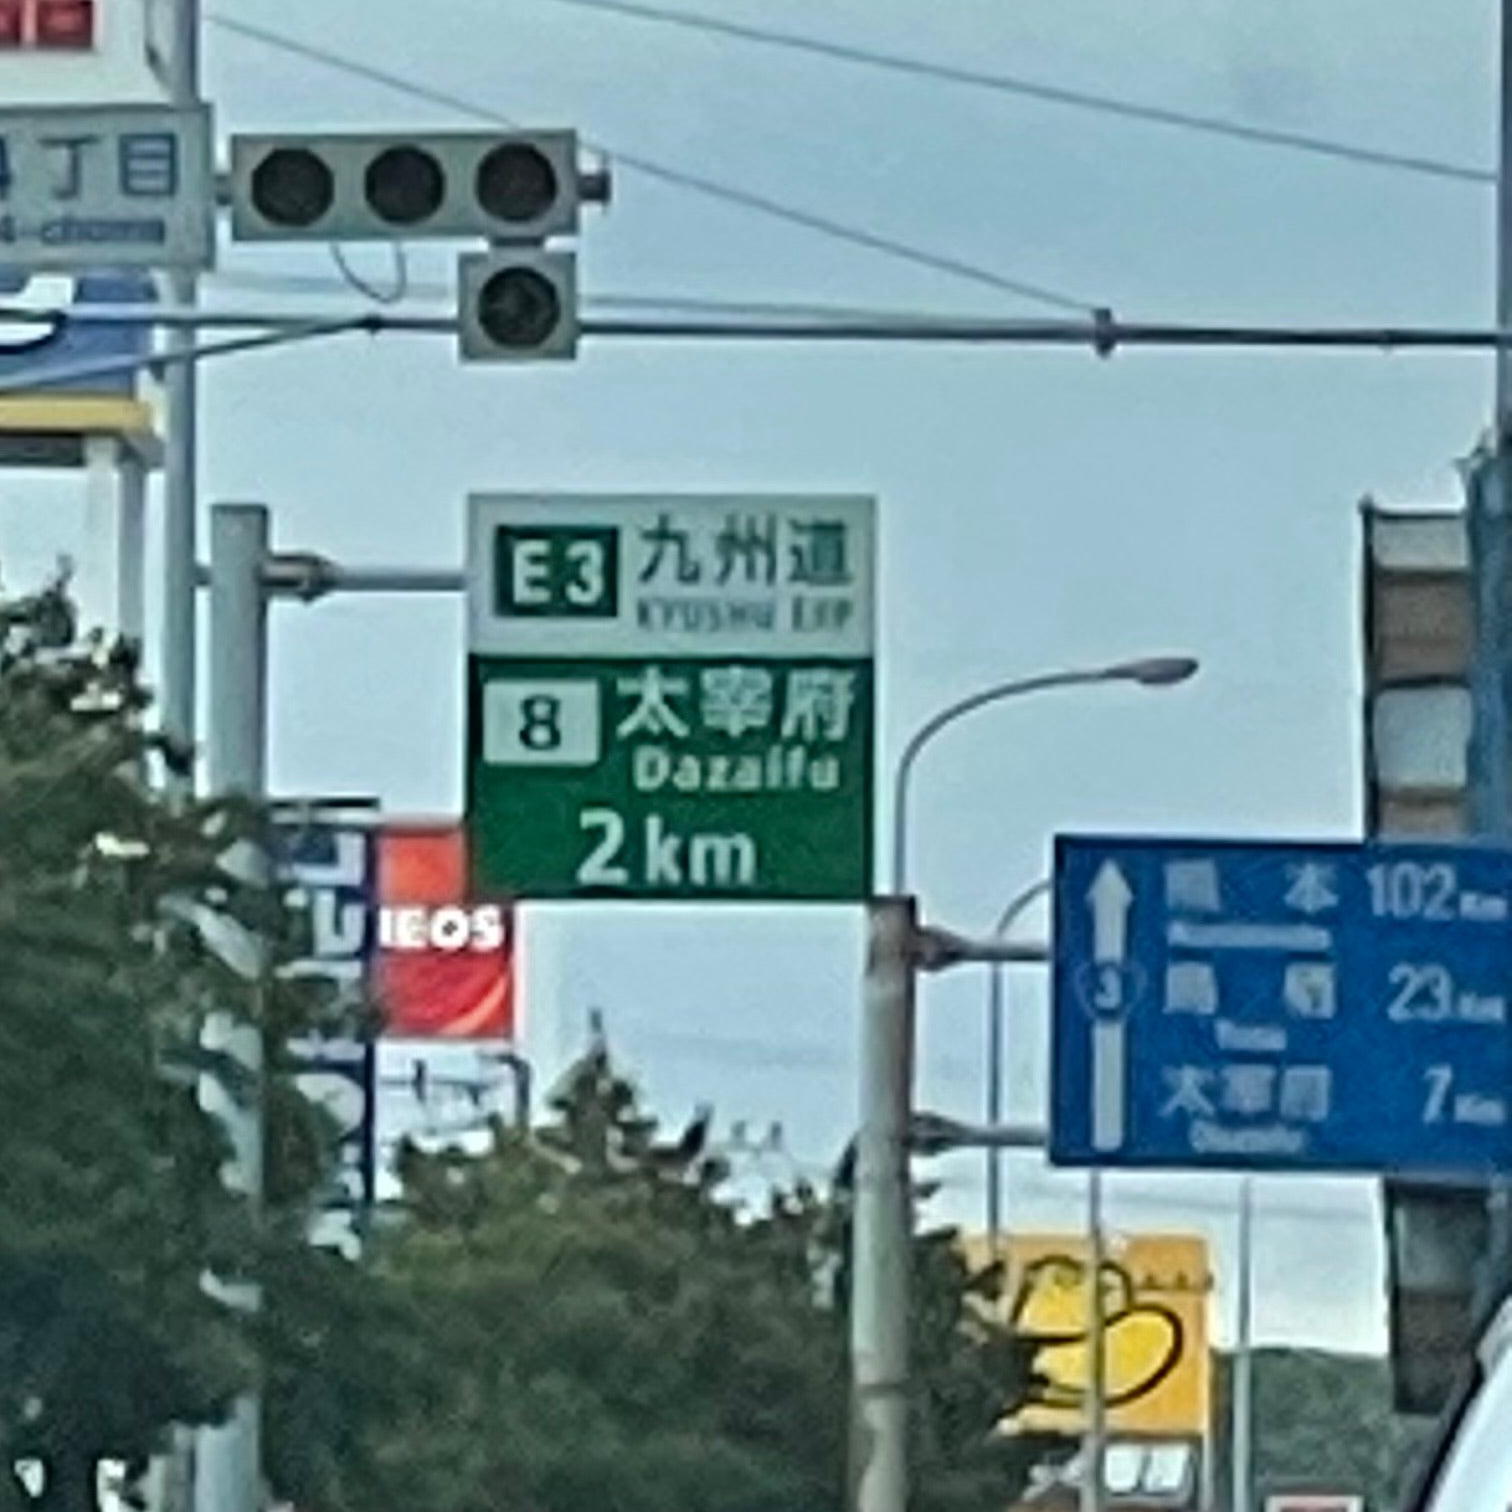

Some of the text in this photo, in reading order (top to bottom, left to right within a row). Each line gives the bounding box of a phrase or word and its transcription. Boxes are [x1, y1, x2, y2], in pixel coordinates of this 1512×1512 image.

[512, 538, 606, 605] E3
[519, 667, 856, 751] 8 太宰府
[633, 743, 841, 791] Dazaifu
